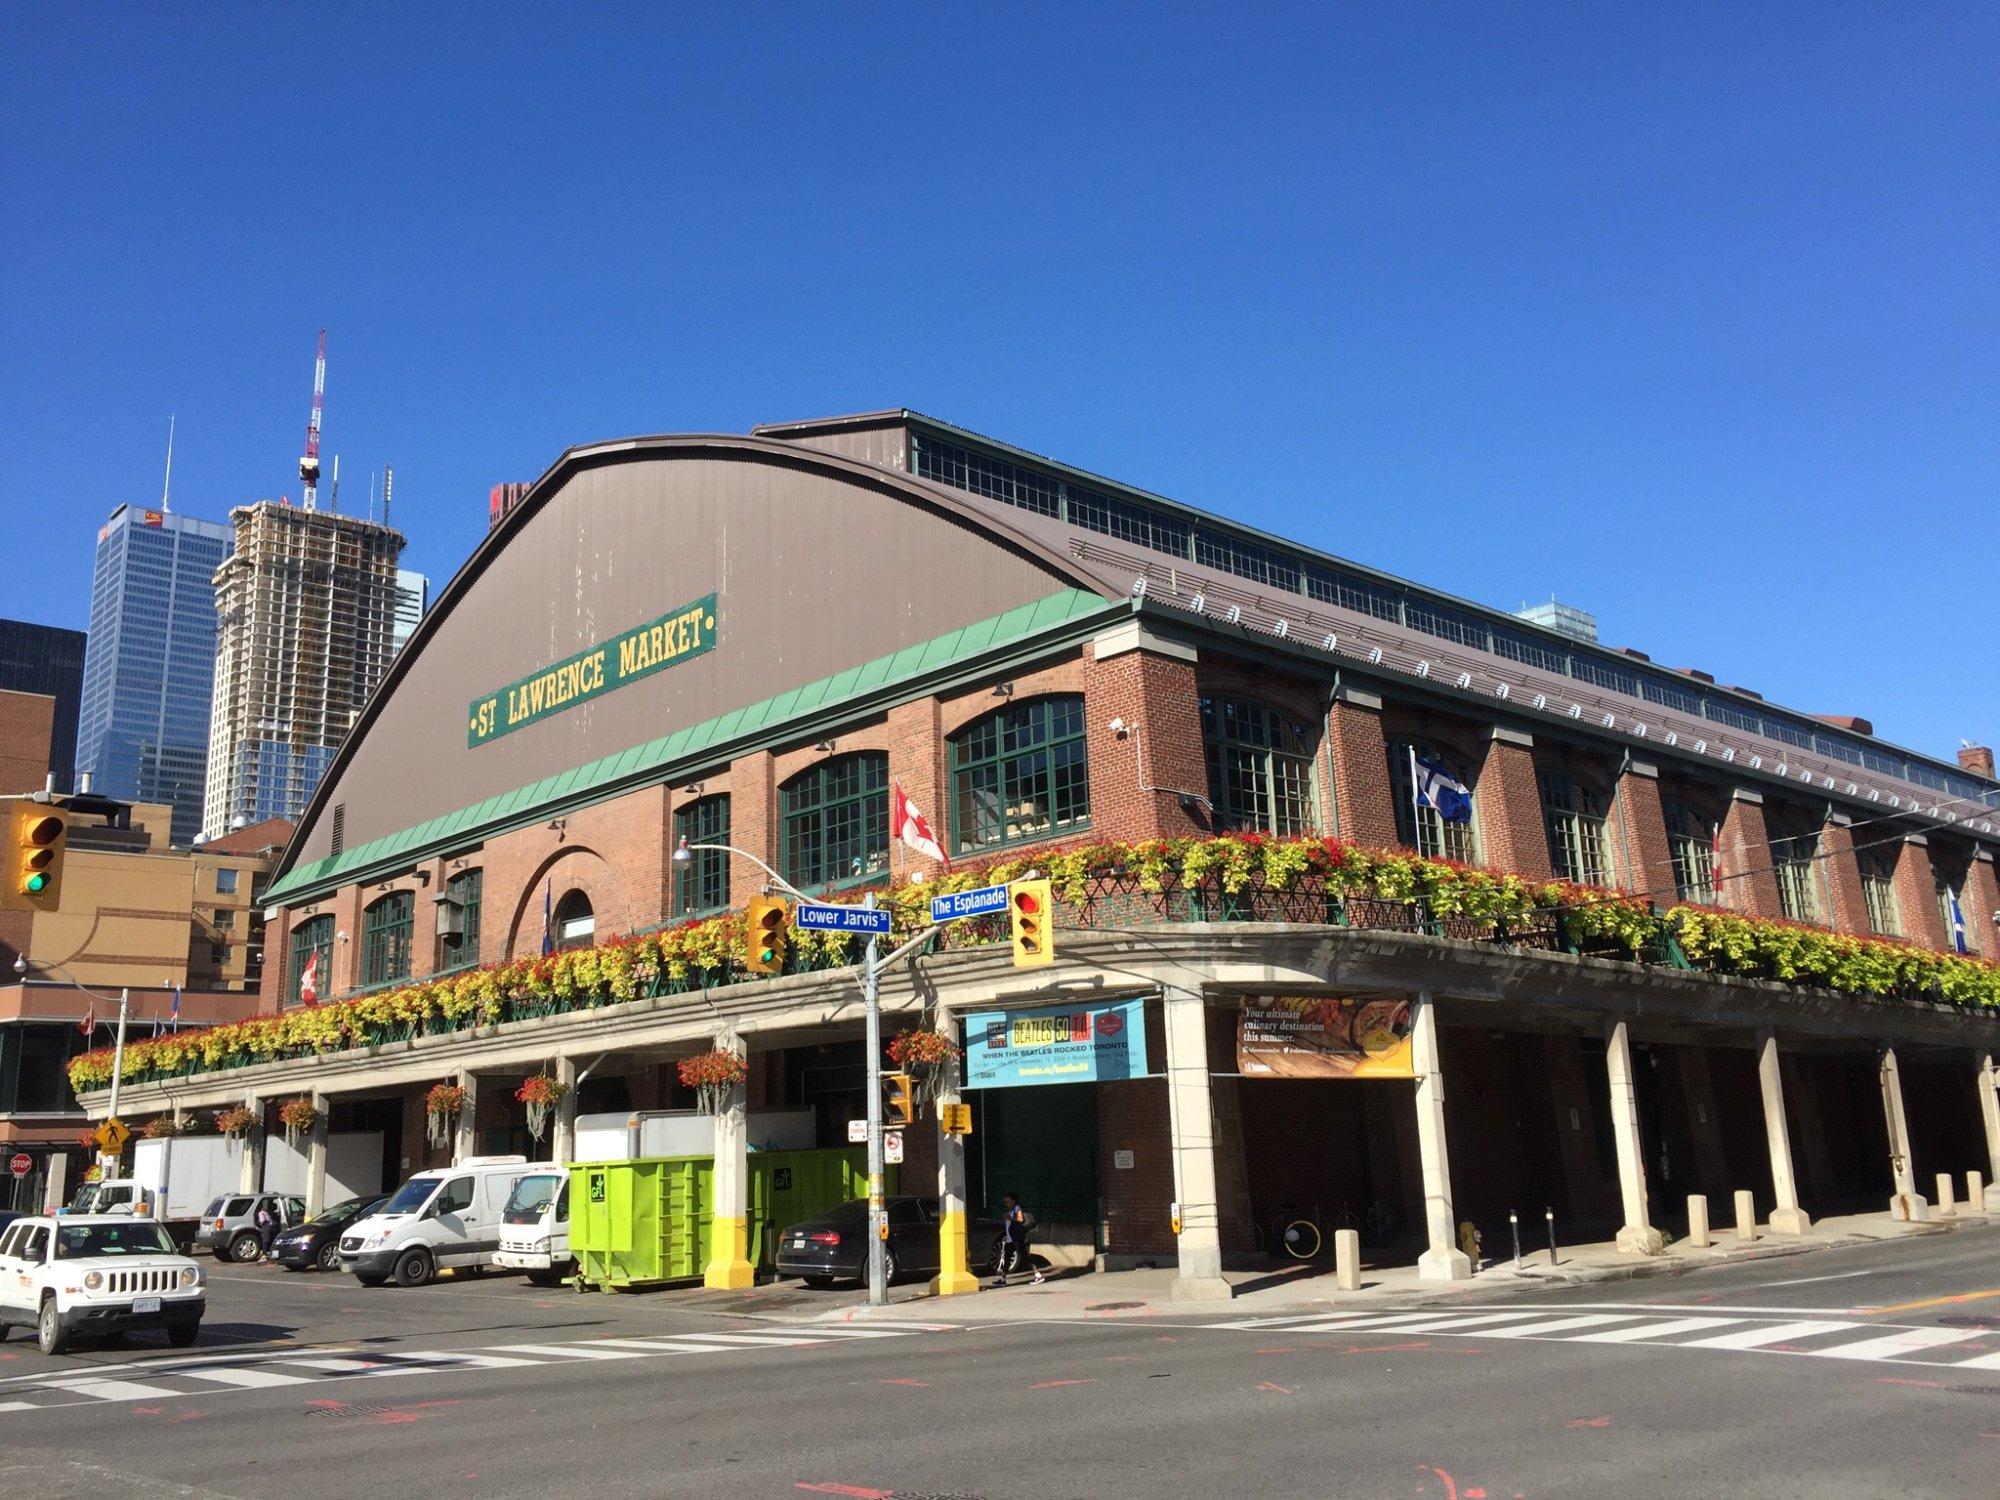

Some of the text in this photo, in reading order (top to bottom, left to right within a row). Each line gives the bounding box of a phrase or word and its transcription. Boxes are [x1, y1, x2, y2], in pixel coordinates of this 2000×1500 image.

[508, 650, 605, 725] LAWRENCE
[618, 606, 704, 678] MARKET
[934, 888, 1005, 915] The Esplanade
[801, 907, 887, 927] Lower Jarvis St
[1245, 1007, 1301, 1019] Your ultimate
[1014, 1020, 1052, 1043] BEATLES
[1056, 1017, 1069, 1041] 50
[1244, 1020, 1325, 1032] culinary destination
[1243, 1031, 1295, 1042] this summer.
[1005, 1050, 1020, 1058] THE
[1020, 1048, 1052, 1057] BEATLES
[1054, 1045, 1087, 1054] ROCKED
[1089, 1041, 1128, 1051] TORONTO
[12, 1159, 30, 1169] STOP
[591, 1186, 604, 1198] GFL
